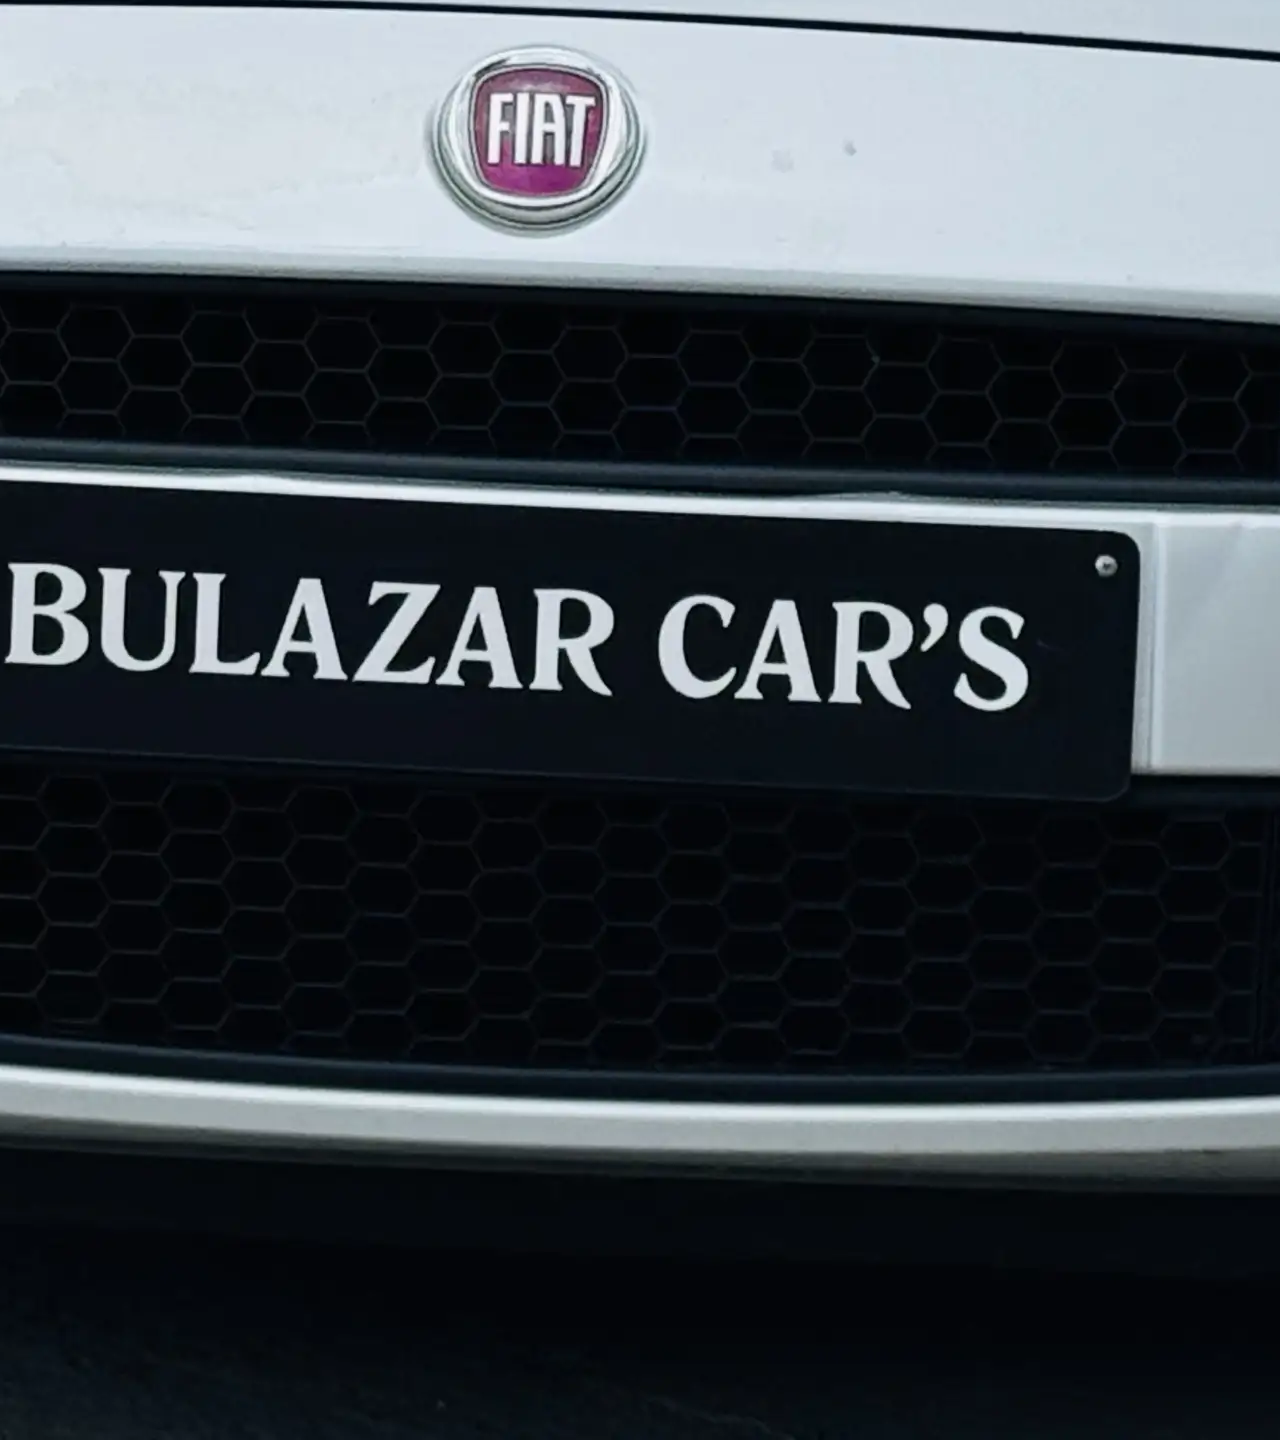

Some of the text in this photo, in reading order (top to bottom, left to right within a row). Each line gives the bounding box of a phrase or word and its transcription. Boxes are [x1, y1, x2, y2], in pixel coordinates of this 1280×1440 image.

[487, 91, 596, 168] FIAT
[5, 563, 1028, 711] BULAZAR CAR'S
